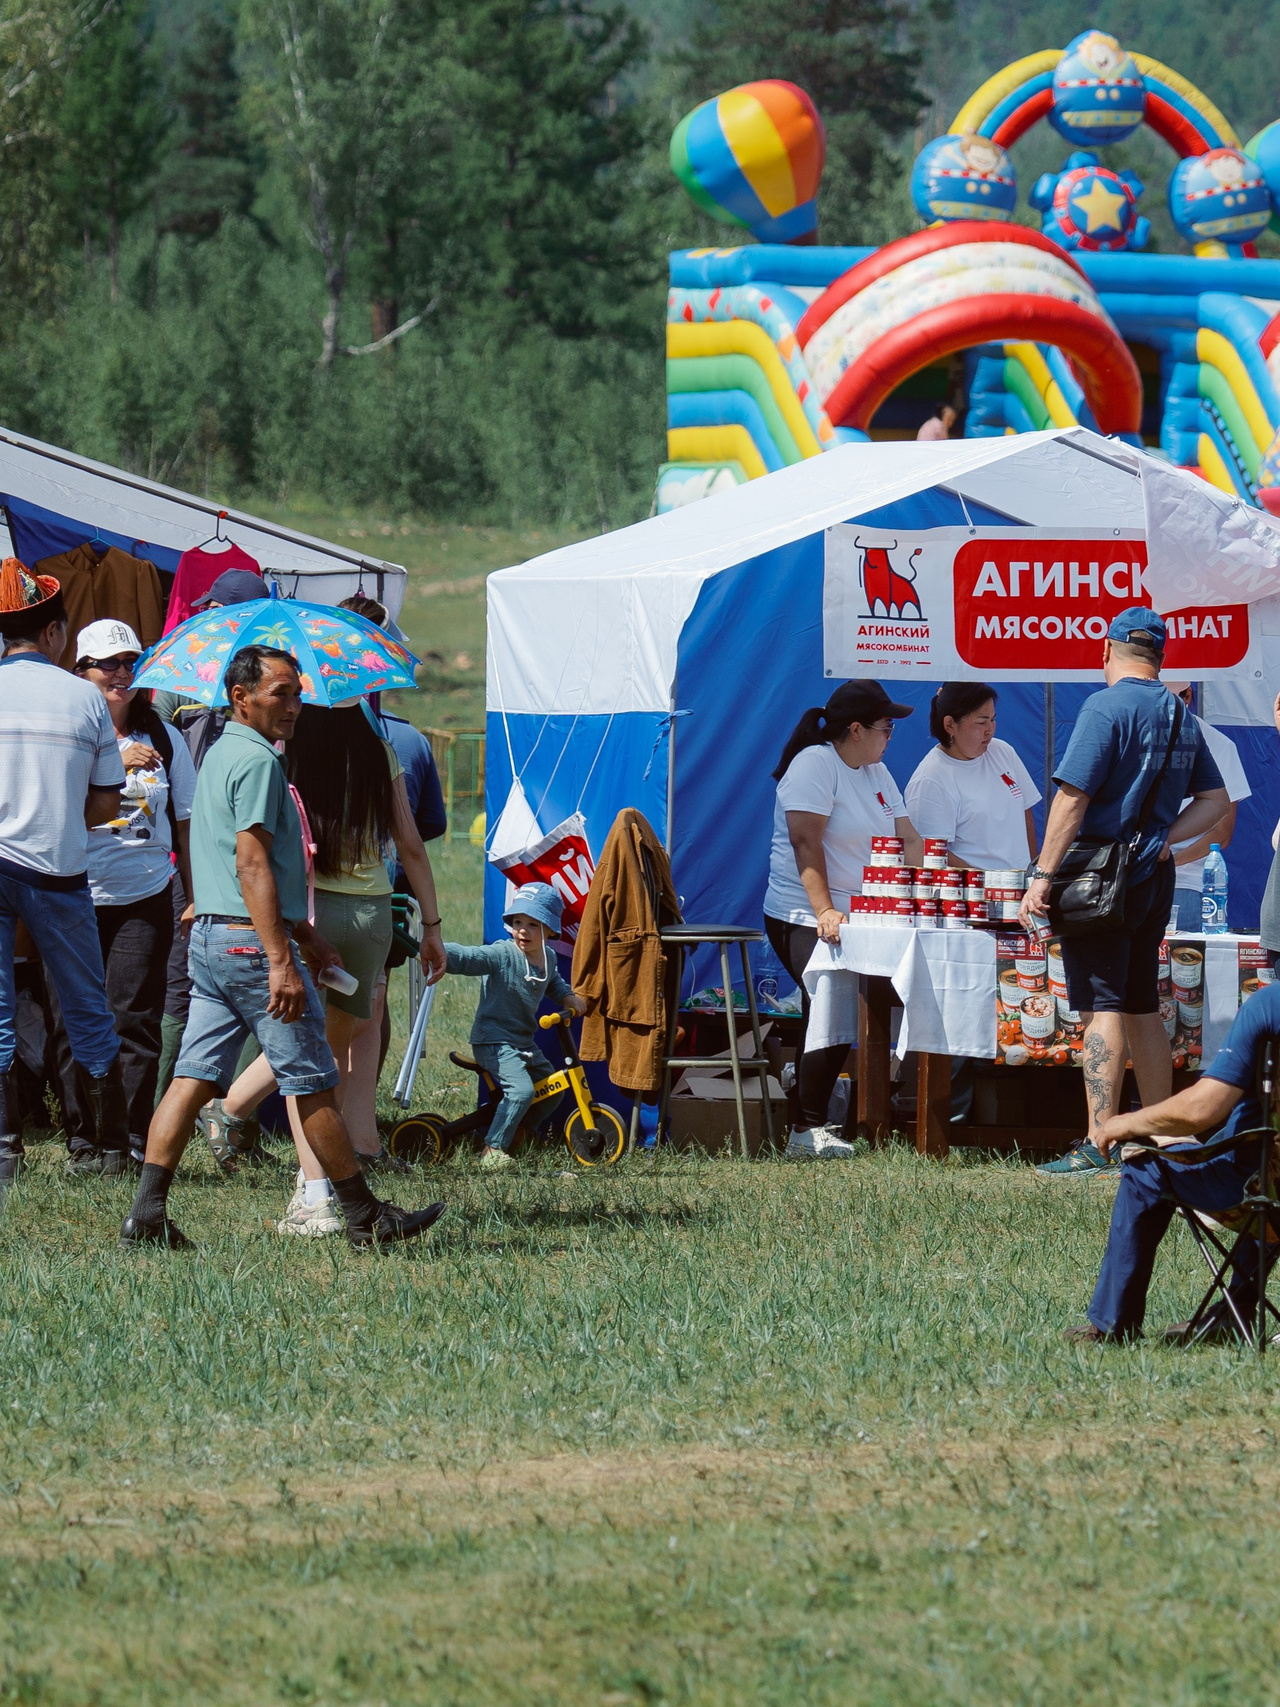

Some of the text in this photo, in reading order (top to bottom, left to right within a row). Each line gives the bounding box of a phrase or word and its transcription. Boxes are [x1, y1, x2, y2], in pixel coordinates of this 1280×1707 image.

[972, 561, 1149, 598] АГИНСК
[857, 624, 930, 638] АГИНСКИЙ
[974, 614, 1232, 640] МЯСОКОИНАТ
[856, 643, 930, 653] МЯСОКОМБИНАТ
